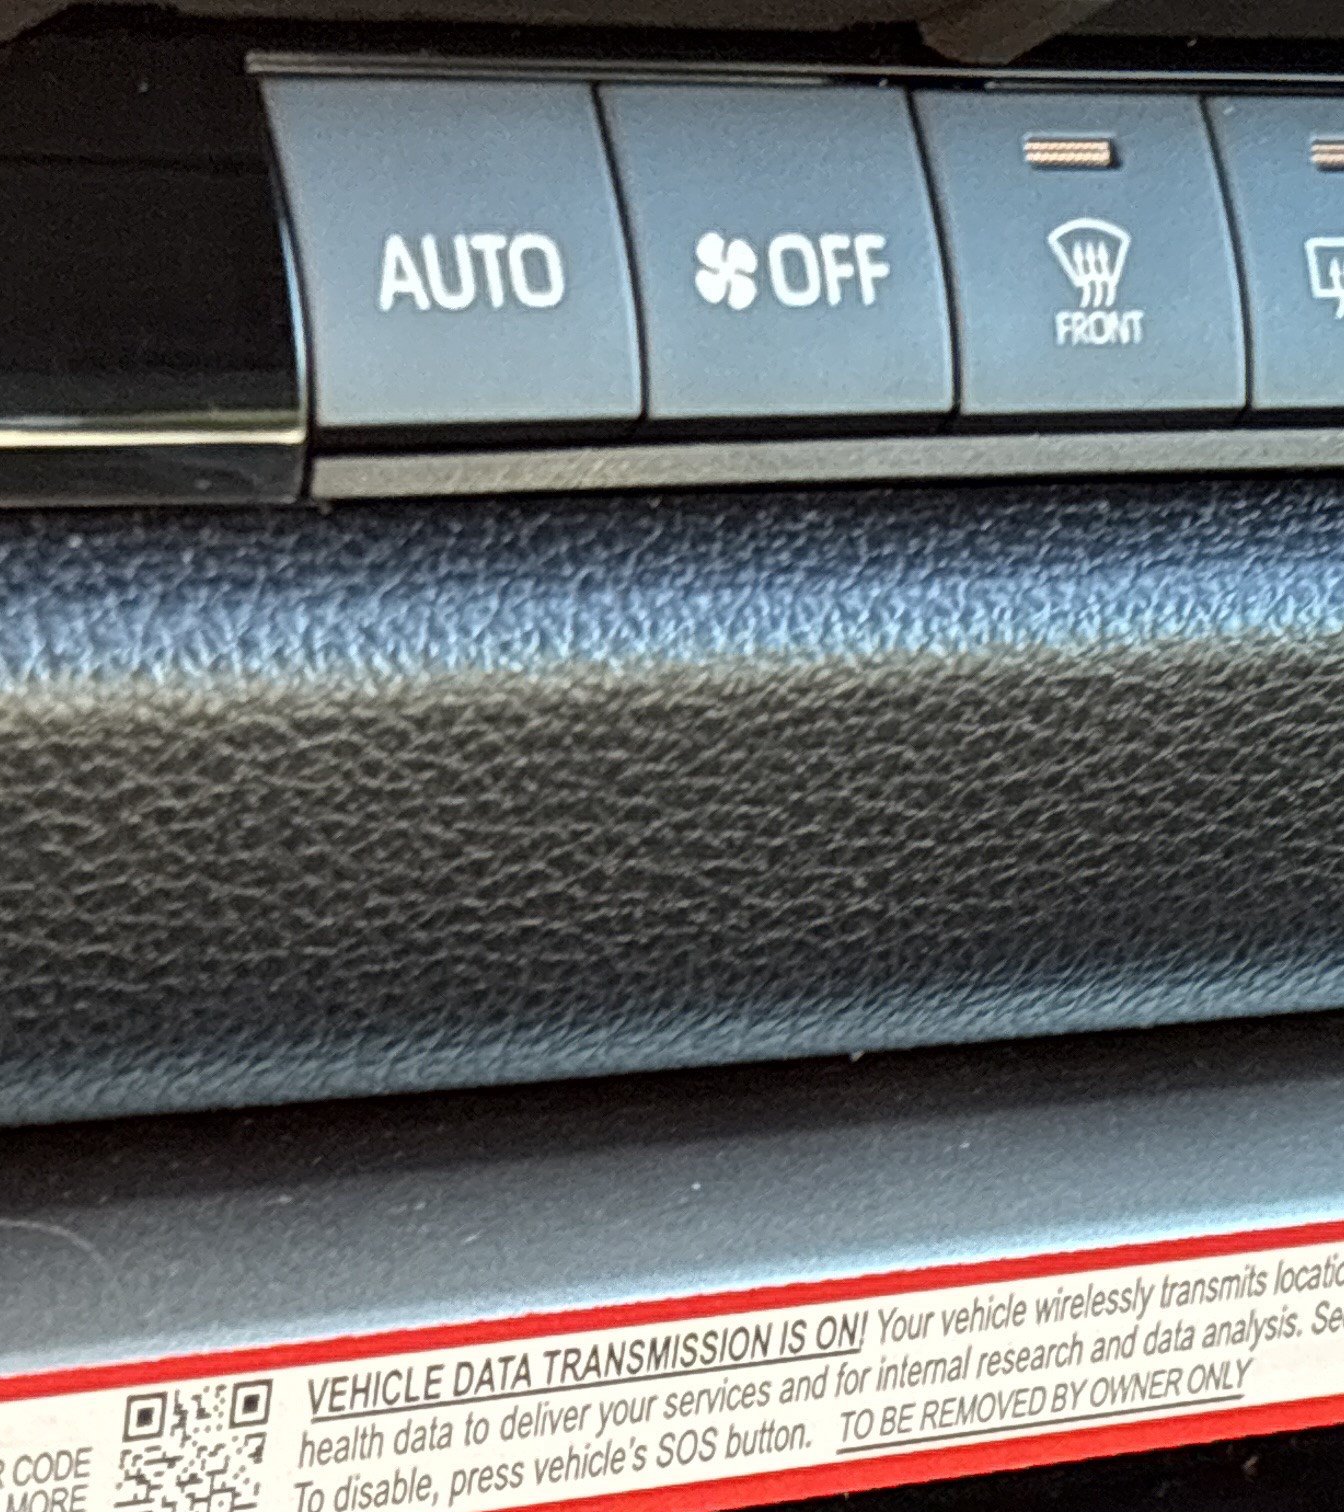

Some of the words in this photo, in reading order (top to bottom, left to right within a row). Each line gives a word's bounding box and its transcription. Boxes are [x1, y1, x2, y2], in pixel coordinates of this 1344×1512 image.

[379, 233, 566, 312] AUTO
[769, 232, 890, 308] OFF
[1056, 311, 1144, 346] FRONT
[307, 1364, 445, 1416] VEHICLE
[456, 1355, 532, 1397] DATA
[543, 1324, 770, 1386] TRANSMISSION
[780, 1320, 806, 1355] IS
[816, 1311, 869, 1348] ON!
[877, 1307, 934, 1344] Your
[943, 1293, 1026, 1337] vehicle
[1036, 1277, 1156, 1326] wirelessly
[1160, 1264, 1267, 1309] transmits
[298, 1421, 383, 1468] health
[393, 1416, 453, 1454] data
[464, 1409, 490, 1447] to
[499, 1401, 591, 1442] deliver
[596, 1395, 657, 1438] your
[664, 1376, 771, 1420] services
[778, 1367, 827, 1402] and
[834, 1362, 872, 1400] for
[875, 1350, 971, 1392] internal
[976, 1333, 1083, 1378] research
[1091, 1325, 1139, 1363] and
[1143, 1319, 1195, 1356] data
[1201, 1304, 1302, 1352] analysis.
[13, 1447, 93, 1484] CODE
[448, 1460, 524, 1507] press
[535, 1437, 647, 1487] vehicle's
[656, 1427, 719, 1469] SOS
[725, 1419, 813, 1461] button.
[840, 1410, 873, 1444] TO
[879, 1401, 916, 1435] BE
[919, 1384, 1047, 1431] REMOVED
[1050, 1379, 1088, 1415] BY
[1090, 1368, 1184, 1408] OWNER
[1187, 1356, 1254, 1395] ONLY
